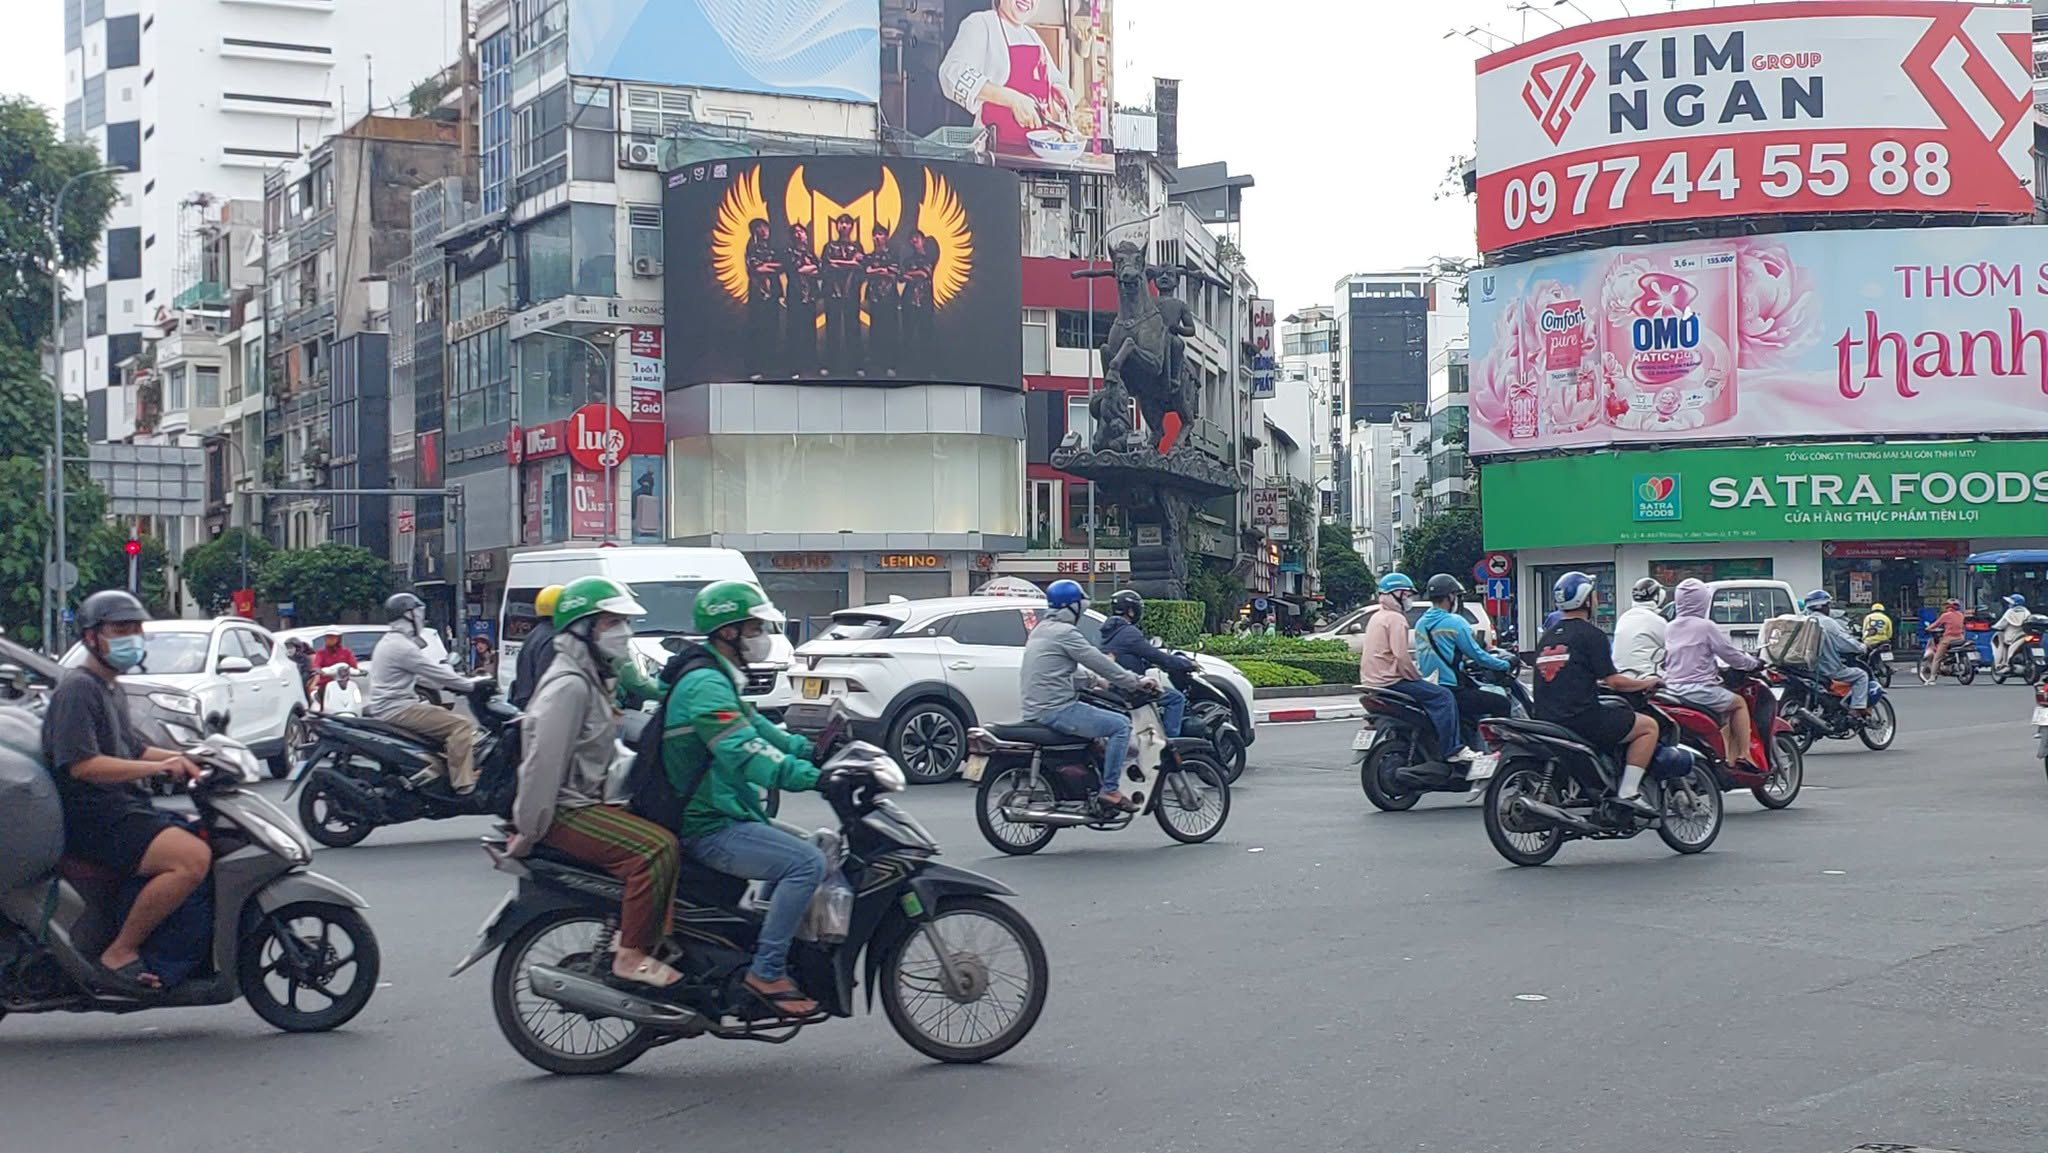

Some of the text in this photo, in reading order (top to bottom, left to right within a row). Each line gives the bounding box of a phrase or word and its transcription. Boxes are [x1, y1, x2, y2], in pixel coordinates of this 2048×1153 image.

[1608, 31, 1822, 86] KIM GROUP
[1609, 75, 1824, 134] NGAN
[1504, 141, 1951, 230] 09 77 44 55 88
[1894, 261, 2022, 298] THƠM
[1541, 306, 1586, 333] Comfort
[638, 331, 654, 342] 25
[1632, 311, 1700, 352] OMO
[1549, 335, 1578, 356] pure
[633, 402, 640, 413] 2
[1708, 473, 1885, 509] SATRA
[1639, 502, 1674, 510] SATRA
[1639, 509, 1674, 517] FOODS
[1855, 510, 1888, 525] THỰC
[1929, 510, 1957, 523] TIỆN
[1959, 510, 1980, 523] LỢI
[880, 556, 936, 568] LEMINO
[1057, 562, 1079, 573] SHE
[1099, 561, 1117, 572] SHI
[706, 600, 739, 616] Grab
